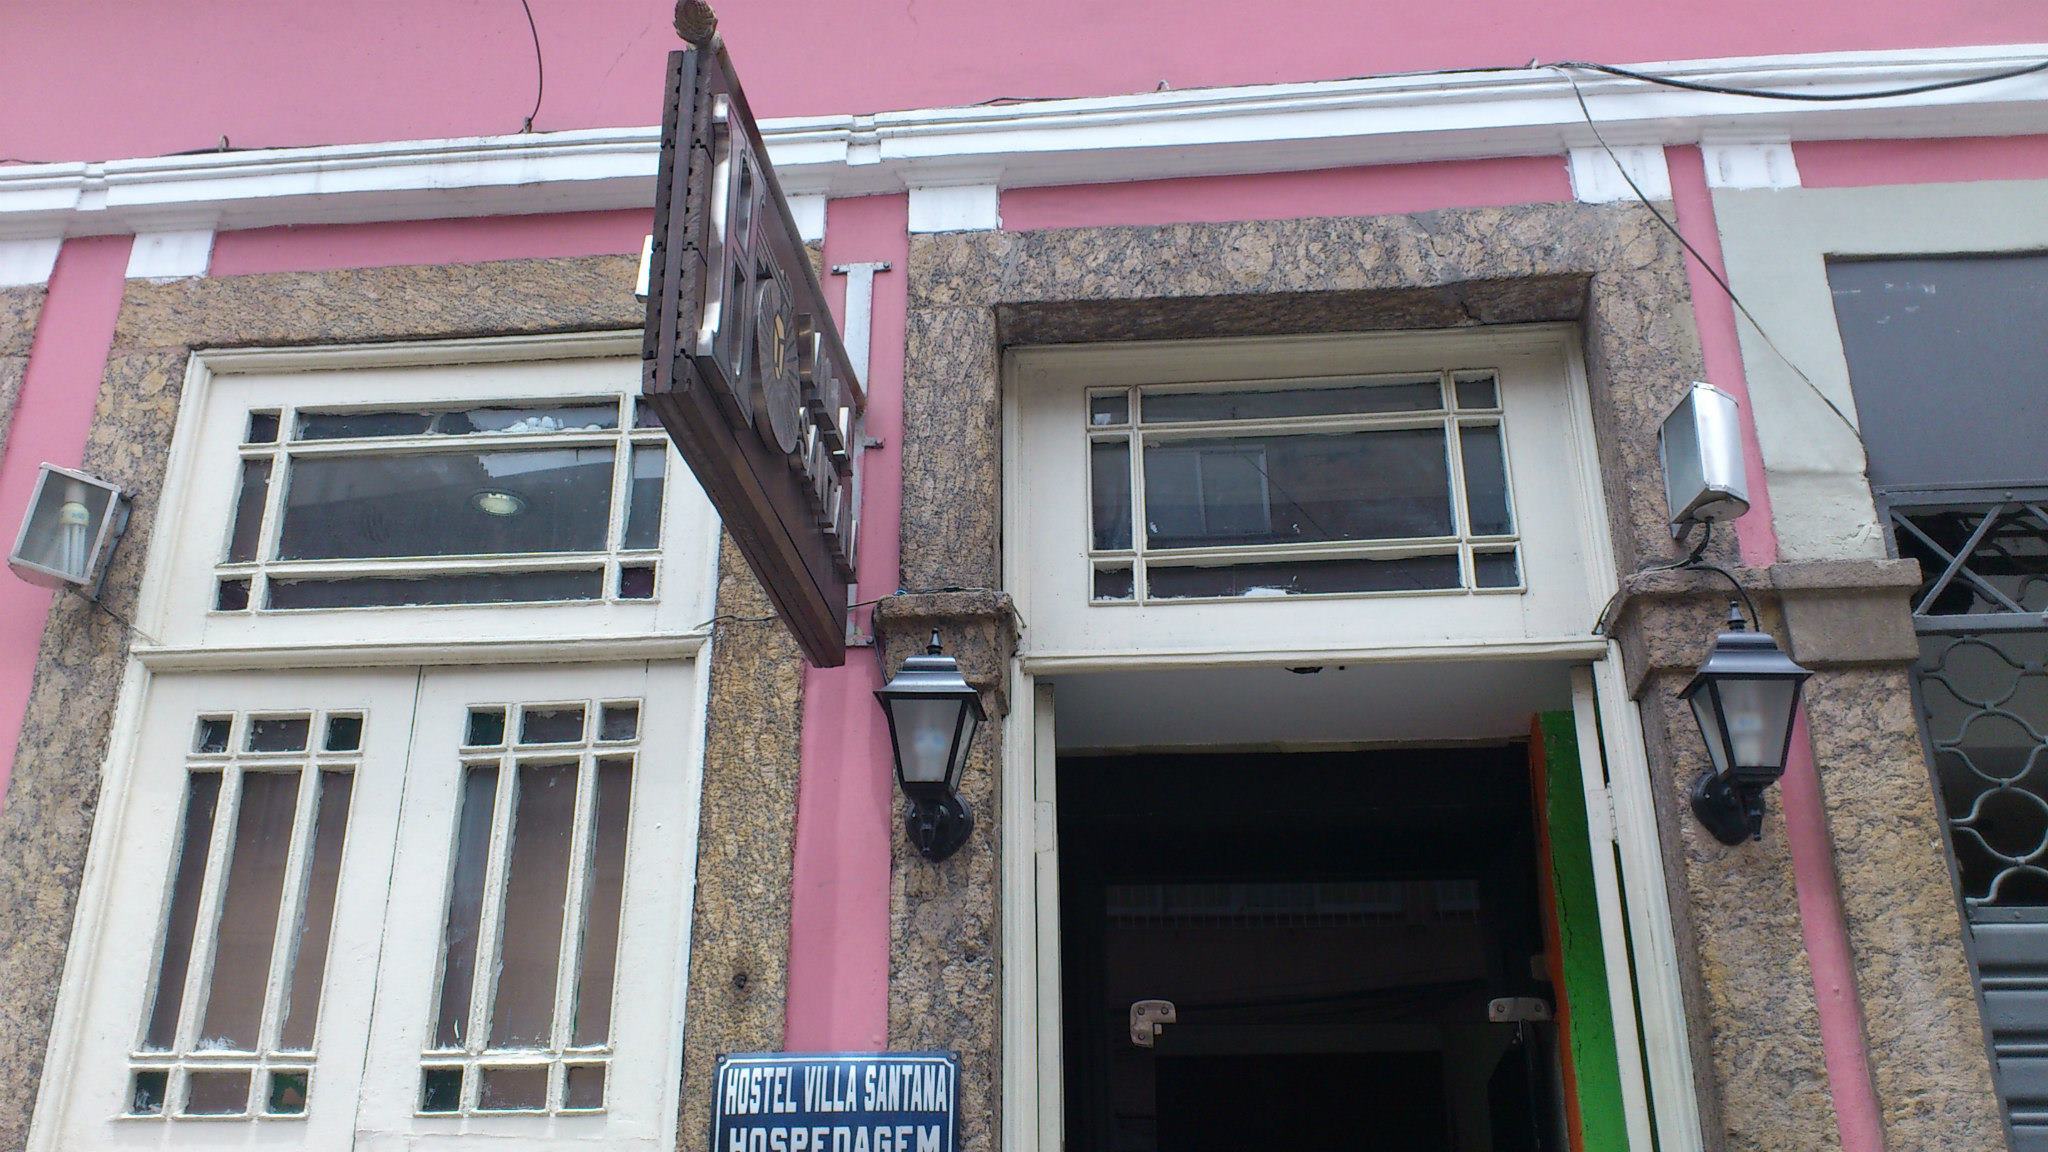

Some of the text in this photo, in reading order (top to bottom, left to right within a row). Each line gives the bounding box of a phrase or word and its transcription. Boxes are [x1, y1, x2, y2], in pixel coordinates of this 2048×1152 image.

[725, 1064, 948, 1115] HOSTEL VILLA SANTANA
[729, 1125, 941, 1152] HOSPEDAGEM
